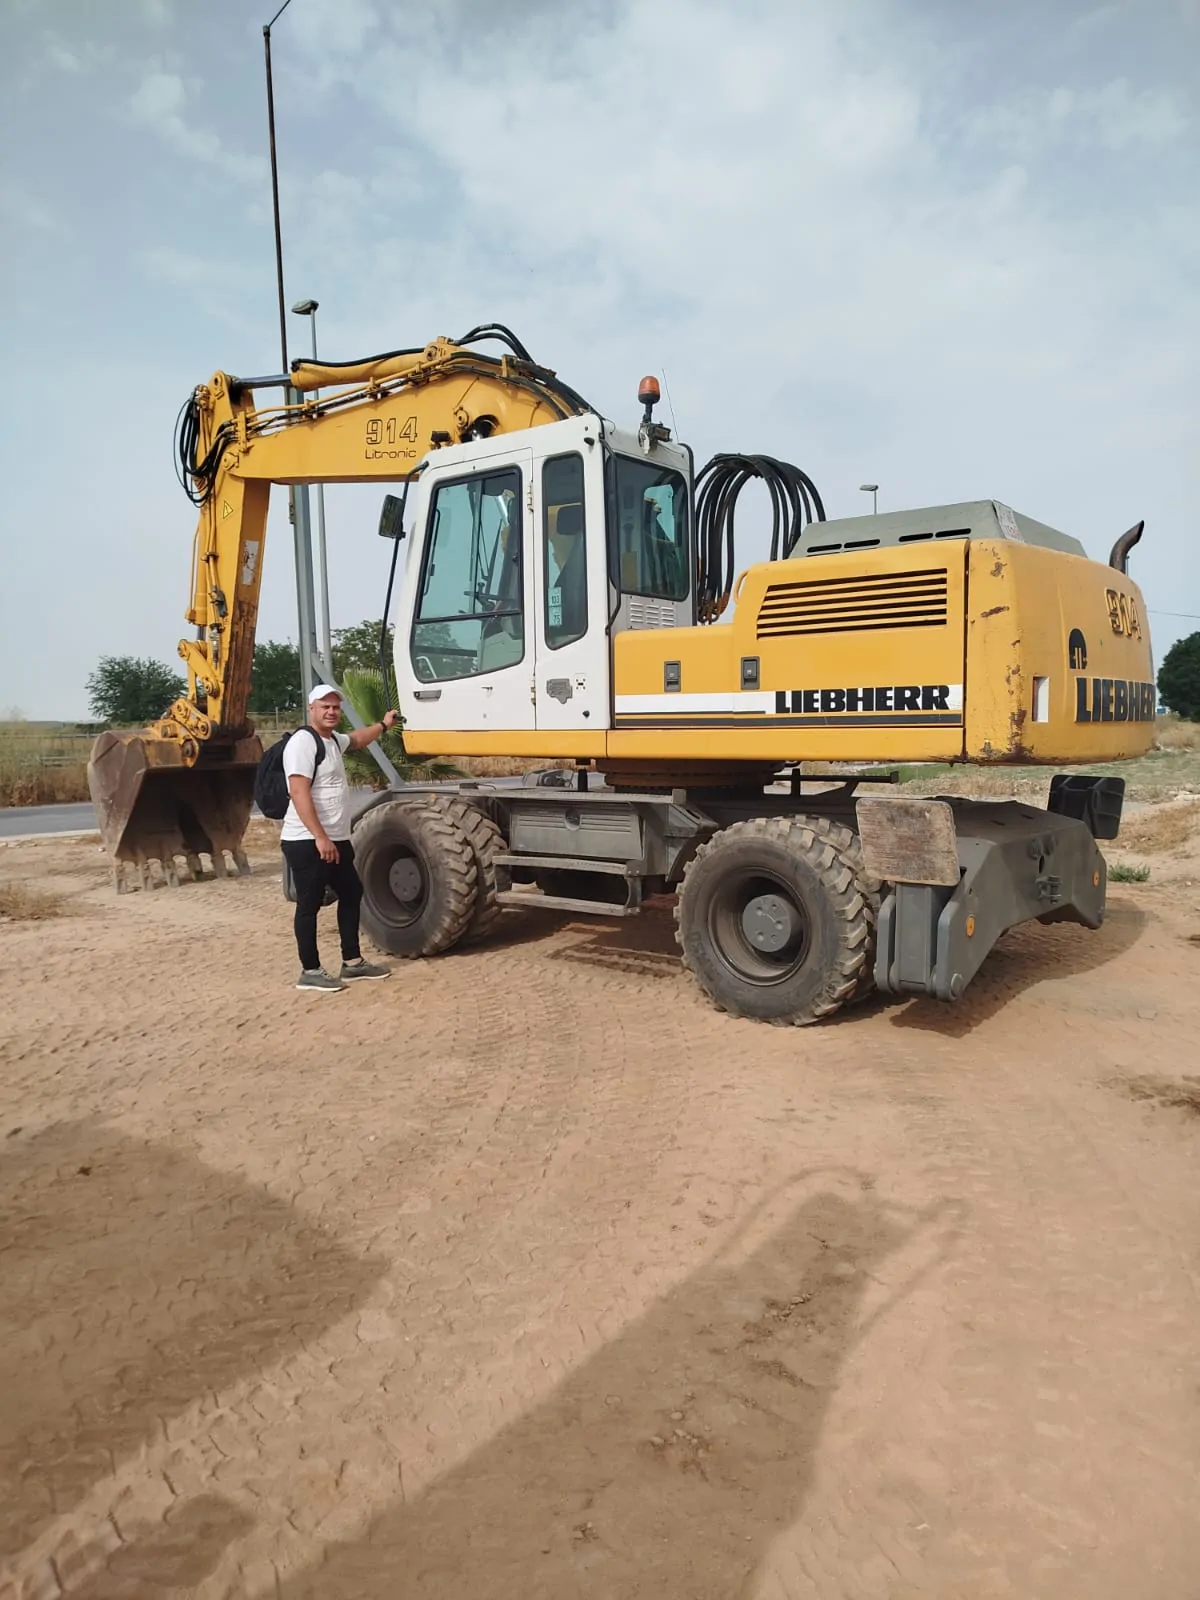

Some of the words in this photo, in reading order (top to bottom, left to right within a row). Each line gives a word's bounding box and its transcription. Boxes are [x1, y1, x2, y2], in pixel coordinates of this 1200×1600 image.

[366, 416, 418, 445] 914
[365, 448, 417, 459] Litronic
[775, 685, 950, 713] LIEBHERR
